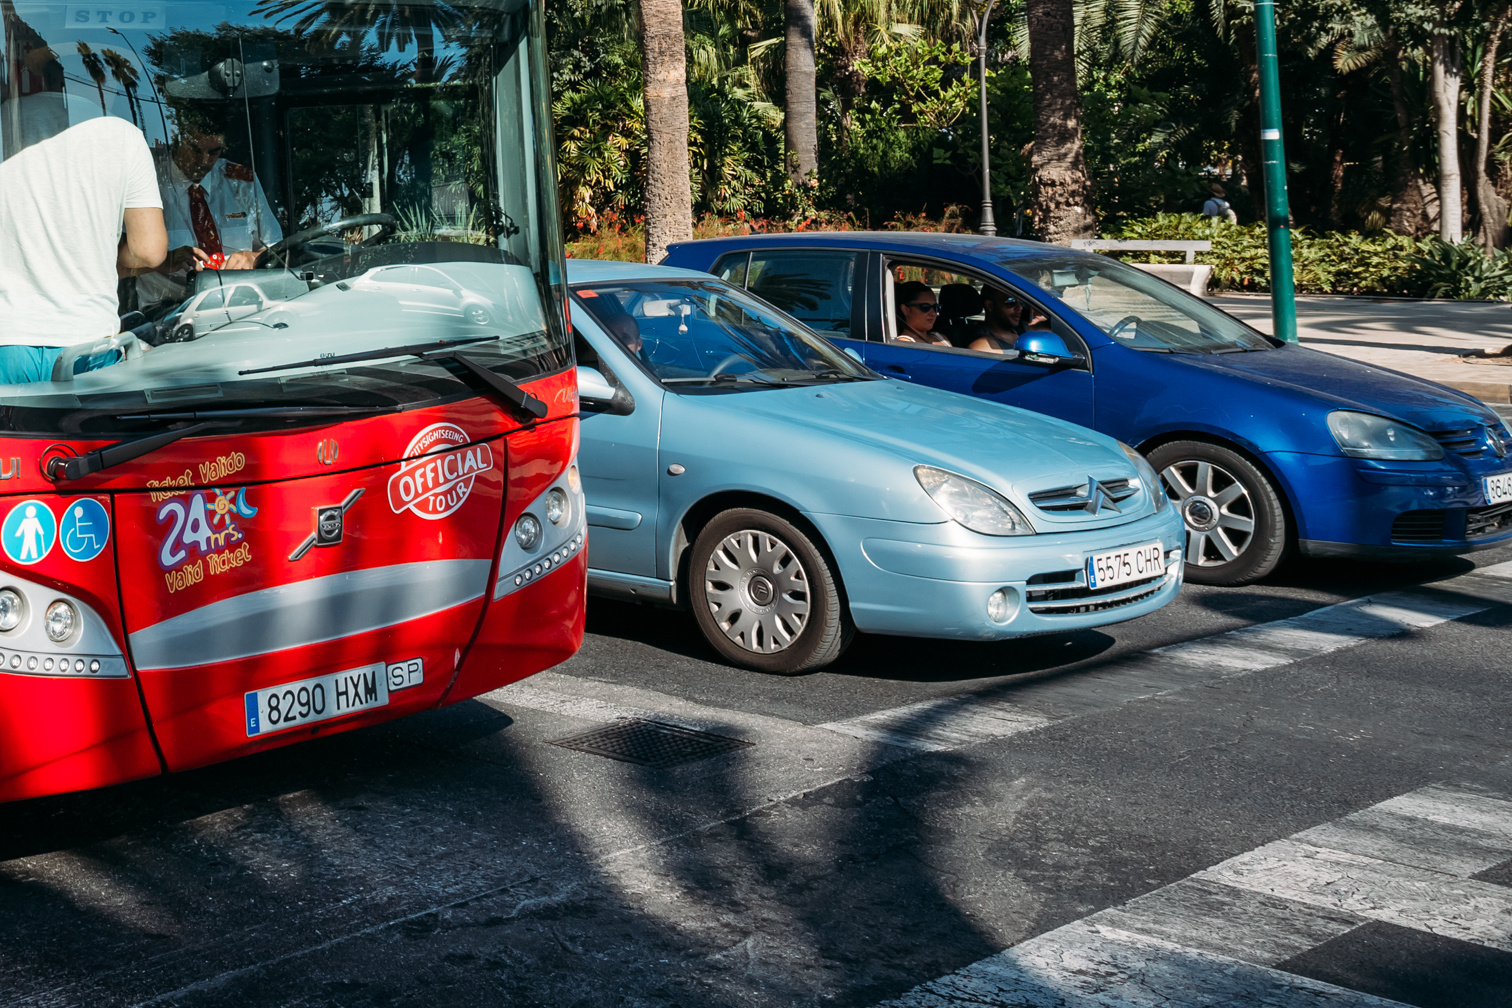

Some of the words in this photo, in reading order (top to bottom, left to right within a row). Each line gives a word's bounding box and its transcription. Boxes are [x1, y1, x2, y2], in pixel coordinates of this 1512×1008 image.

[74, 9, 158, 24] STOP
[410, 429, 464, 461] CITYSIGHTSEEING
[199, 451, 246, 483] Valido
[399, 447, 487, 502] OFFICIAL
[428, 482, 467, 511] TOUR
[159, 494, 212, 566] 24
[165, 560, 204, 593] Valid
[207, 542, 252, 575] Ticket
[1096, 553, 1131, 582] 5575
[1136, 547, 1161, 574] CHR
[391, 661, 419, 687] SP
[267, 683, 325, 725] 8290
[335, 671, 378, 710] HXM
[250, 717, 256, 727] E
